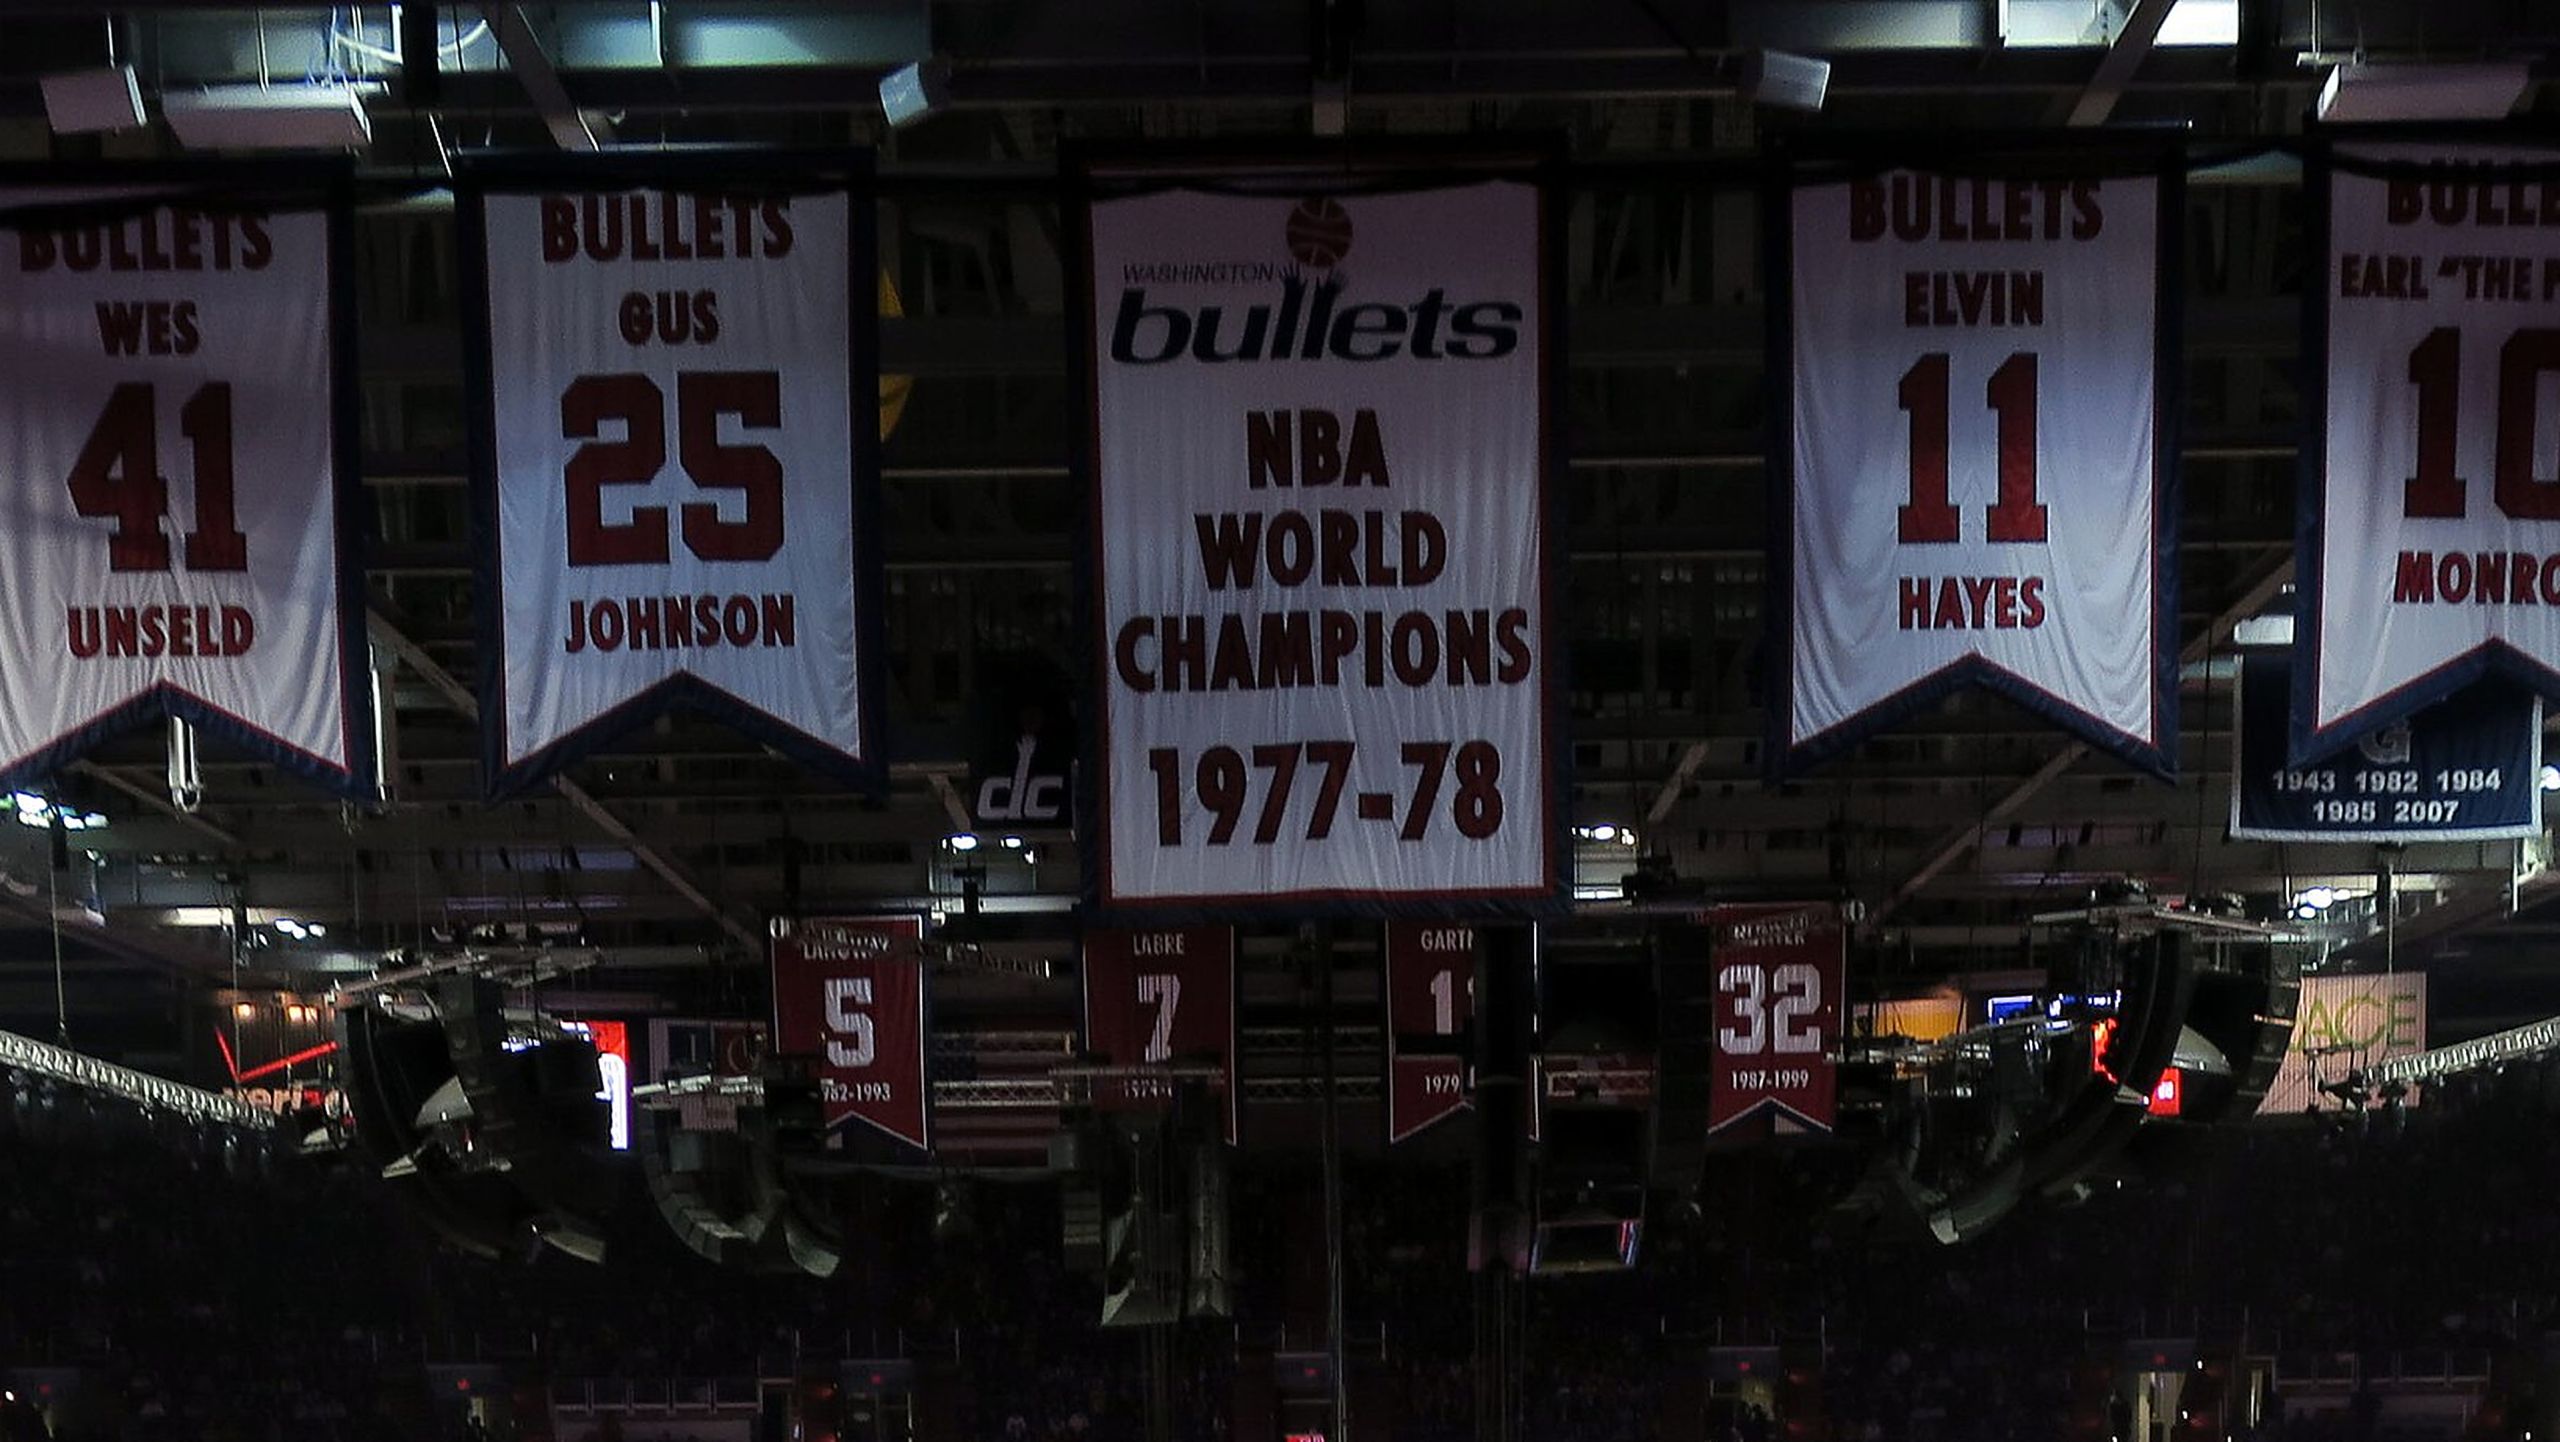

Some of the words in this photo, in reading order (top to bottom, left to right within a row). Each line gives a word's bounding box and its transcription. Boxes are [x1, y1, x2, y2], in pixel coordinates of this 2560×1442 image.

[20, 205, 273, 271] BULLETS
[541, 192, 794, 263] BULLETS
[1850, 174, 2102, 241] BULLETS
[1122, 261, 1276, 284] WASHINGTON
[1905, 271, 2043, 327] ELVIN
[2341, 255, 2428, 299] EARL
[95, 301, 200, 355] WES
[619, 290, 719, 345] GUS
[1111, 268, 1522, 364] bullets
[67, 381, 247, 570] 41
[561, 371, 784, 567] 25
[1246, 409, 1390, 488] NBA
[1898, 353, 2048, 543] 11
[1195, 510, 1446, 589] WORLD
[67, 605, 254, 658] UNSELD
[565, 595, 795, 653] JOHNSON
[1900, 577, 2044, 629] HAYES
[1115, 608, 1531, 692] CHAMPIONS
[1149, 740, 1503, 846] 1977-78
[2272, 769, 2336, 793] 1943
[2354, 769, 2419, 793] 1982
[2436, 768, 2501, 793] 1984
[2312, 800, 2376, 823] 1985
[2393, 800, 2460, 823] 2007
[1132, 932, 1185, 956] LABRE
[823, 976, 875, 1068] 5
[1136, 973, 1182, 1064] 7
[1719, 963, 1822, 1055] 32
[1424, 1074, 1461, 1095] 1979
[1731, 1068, 1810, 1090] 1987-1999
